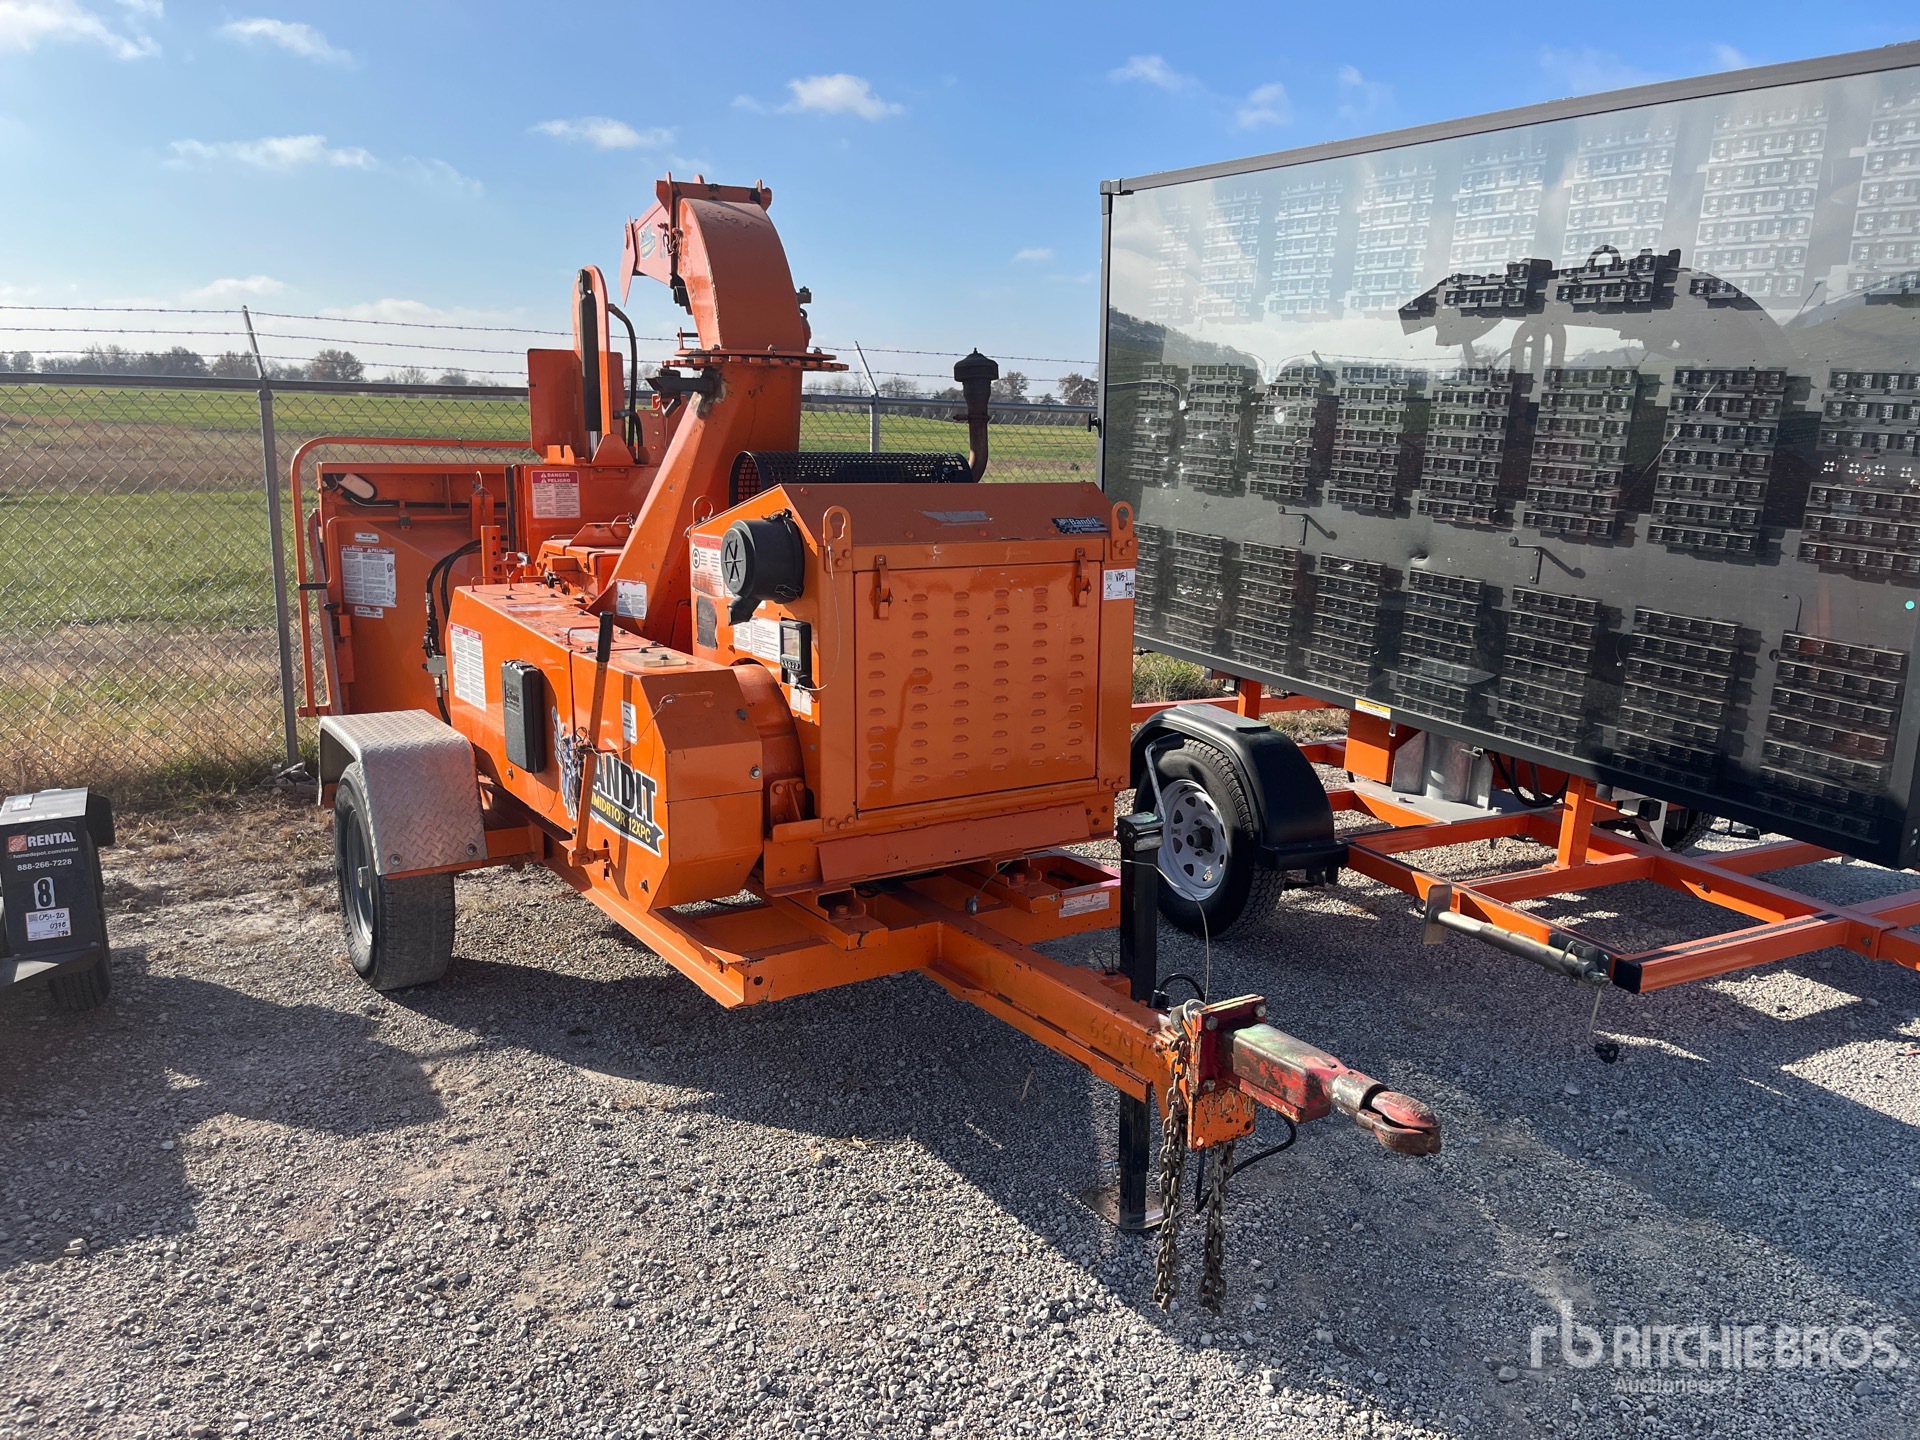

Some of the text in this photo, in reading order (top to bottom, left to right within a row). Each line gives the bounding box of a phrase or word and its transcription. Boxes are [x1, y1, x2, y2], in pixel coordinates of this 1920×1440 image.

[1068, 517, 1098, 525] Bandit
[593, 753, 657, 827] ANDIT
[628, 816, 651, 844] 12XPC
[27, 831, 77, 848] RENTAL
[13, 847, 79, 859] homedepot.com/rental
[17, 858, 73, 872] 888-266-7228
[37, 878, 53, 908] 8
